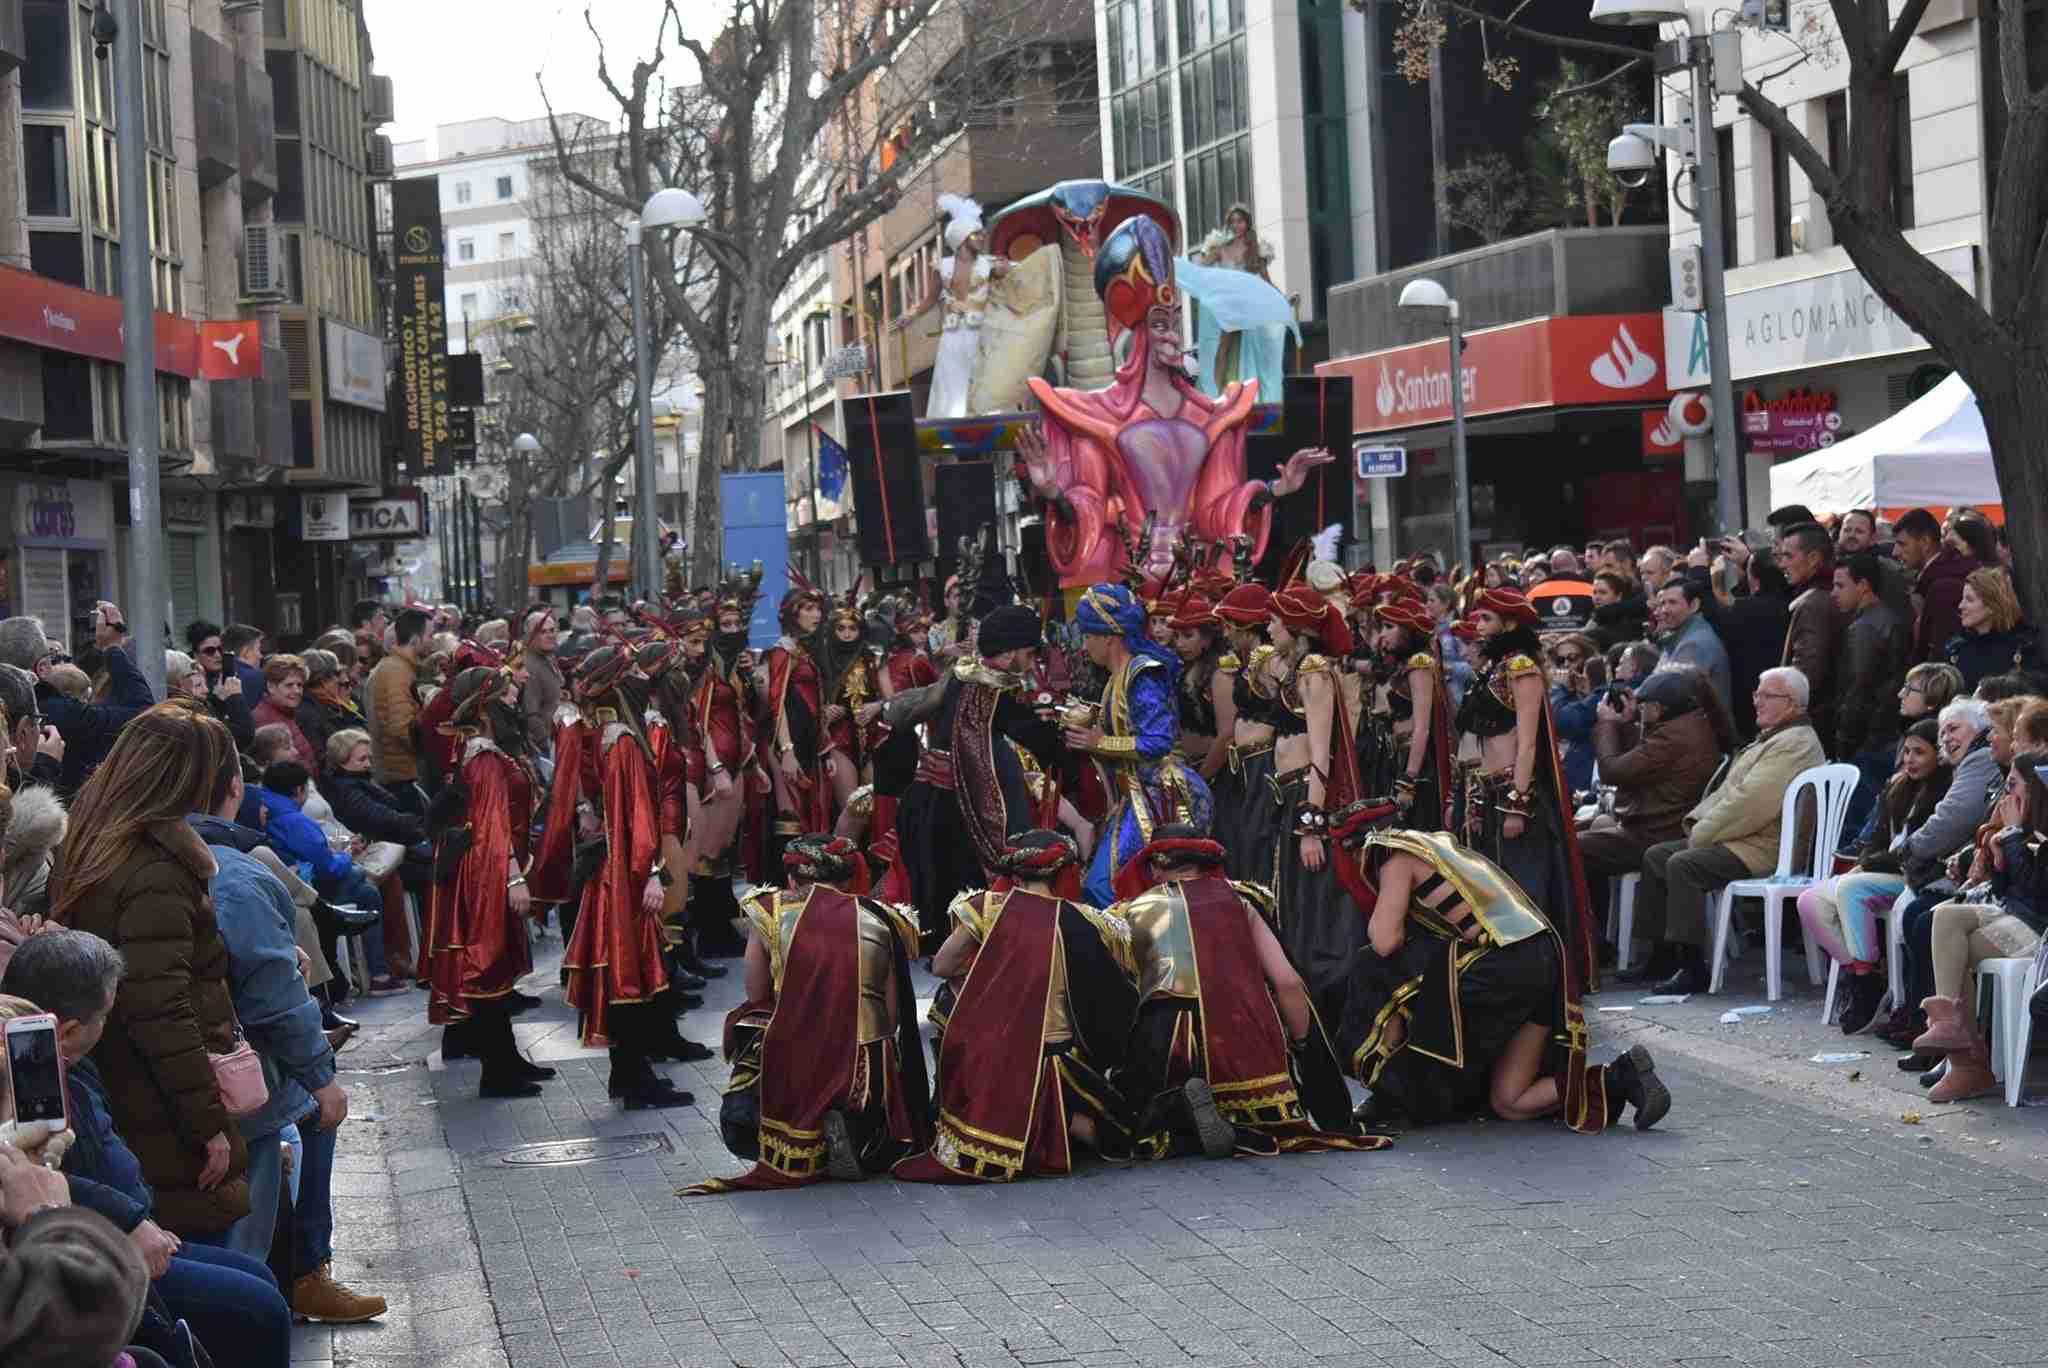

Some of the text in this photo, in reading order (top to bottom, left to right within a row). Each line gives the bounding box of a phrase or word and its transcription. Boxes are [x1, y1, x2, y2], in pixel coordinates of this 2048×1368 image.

[1743, 293, 1896, 345] AGLOMANCH
[429, 302, 449, 443] 926 211 142
[1396, 367, 1477, 413] Santaner
